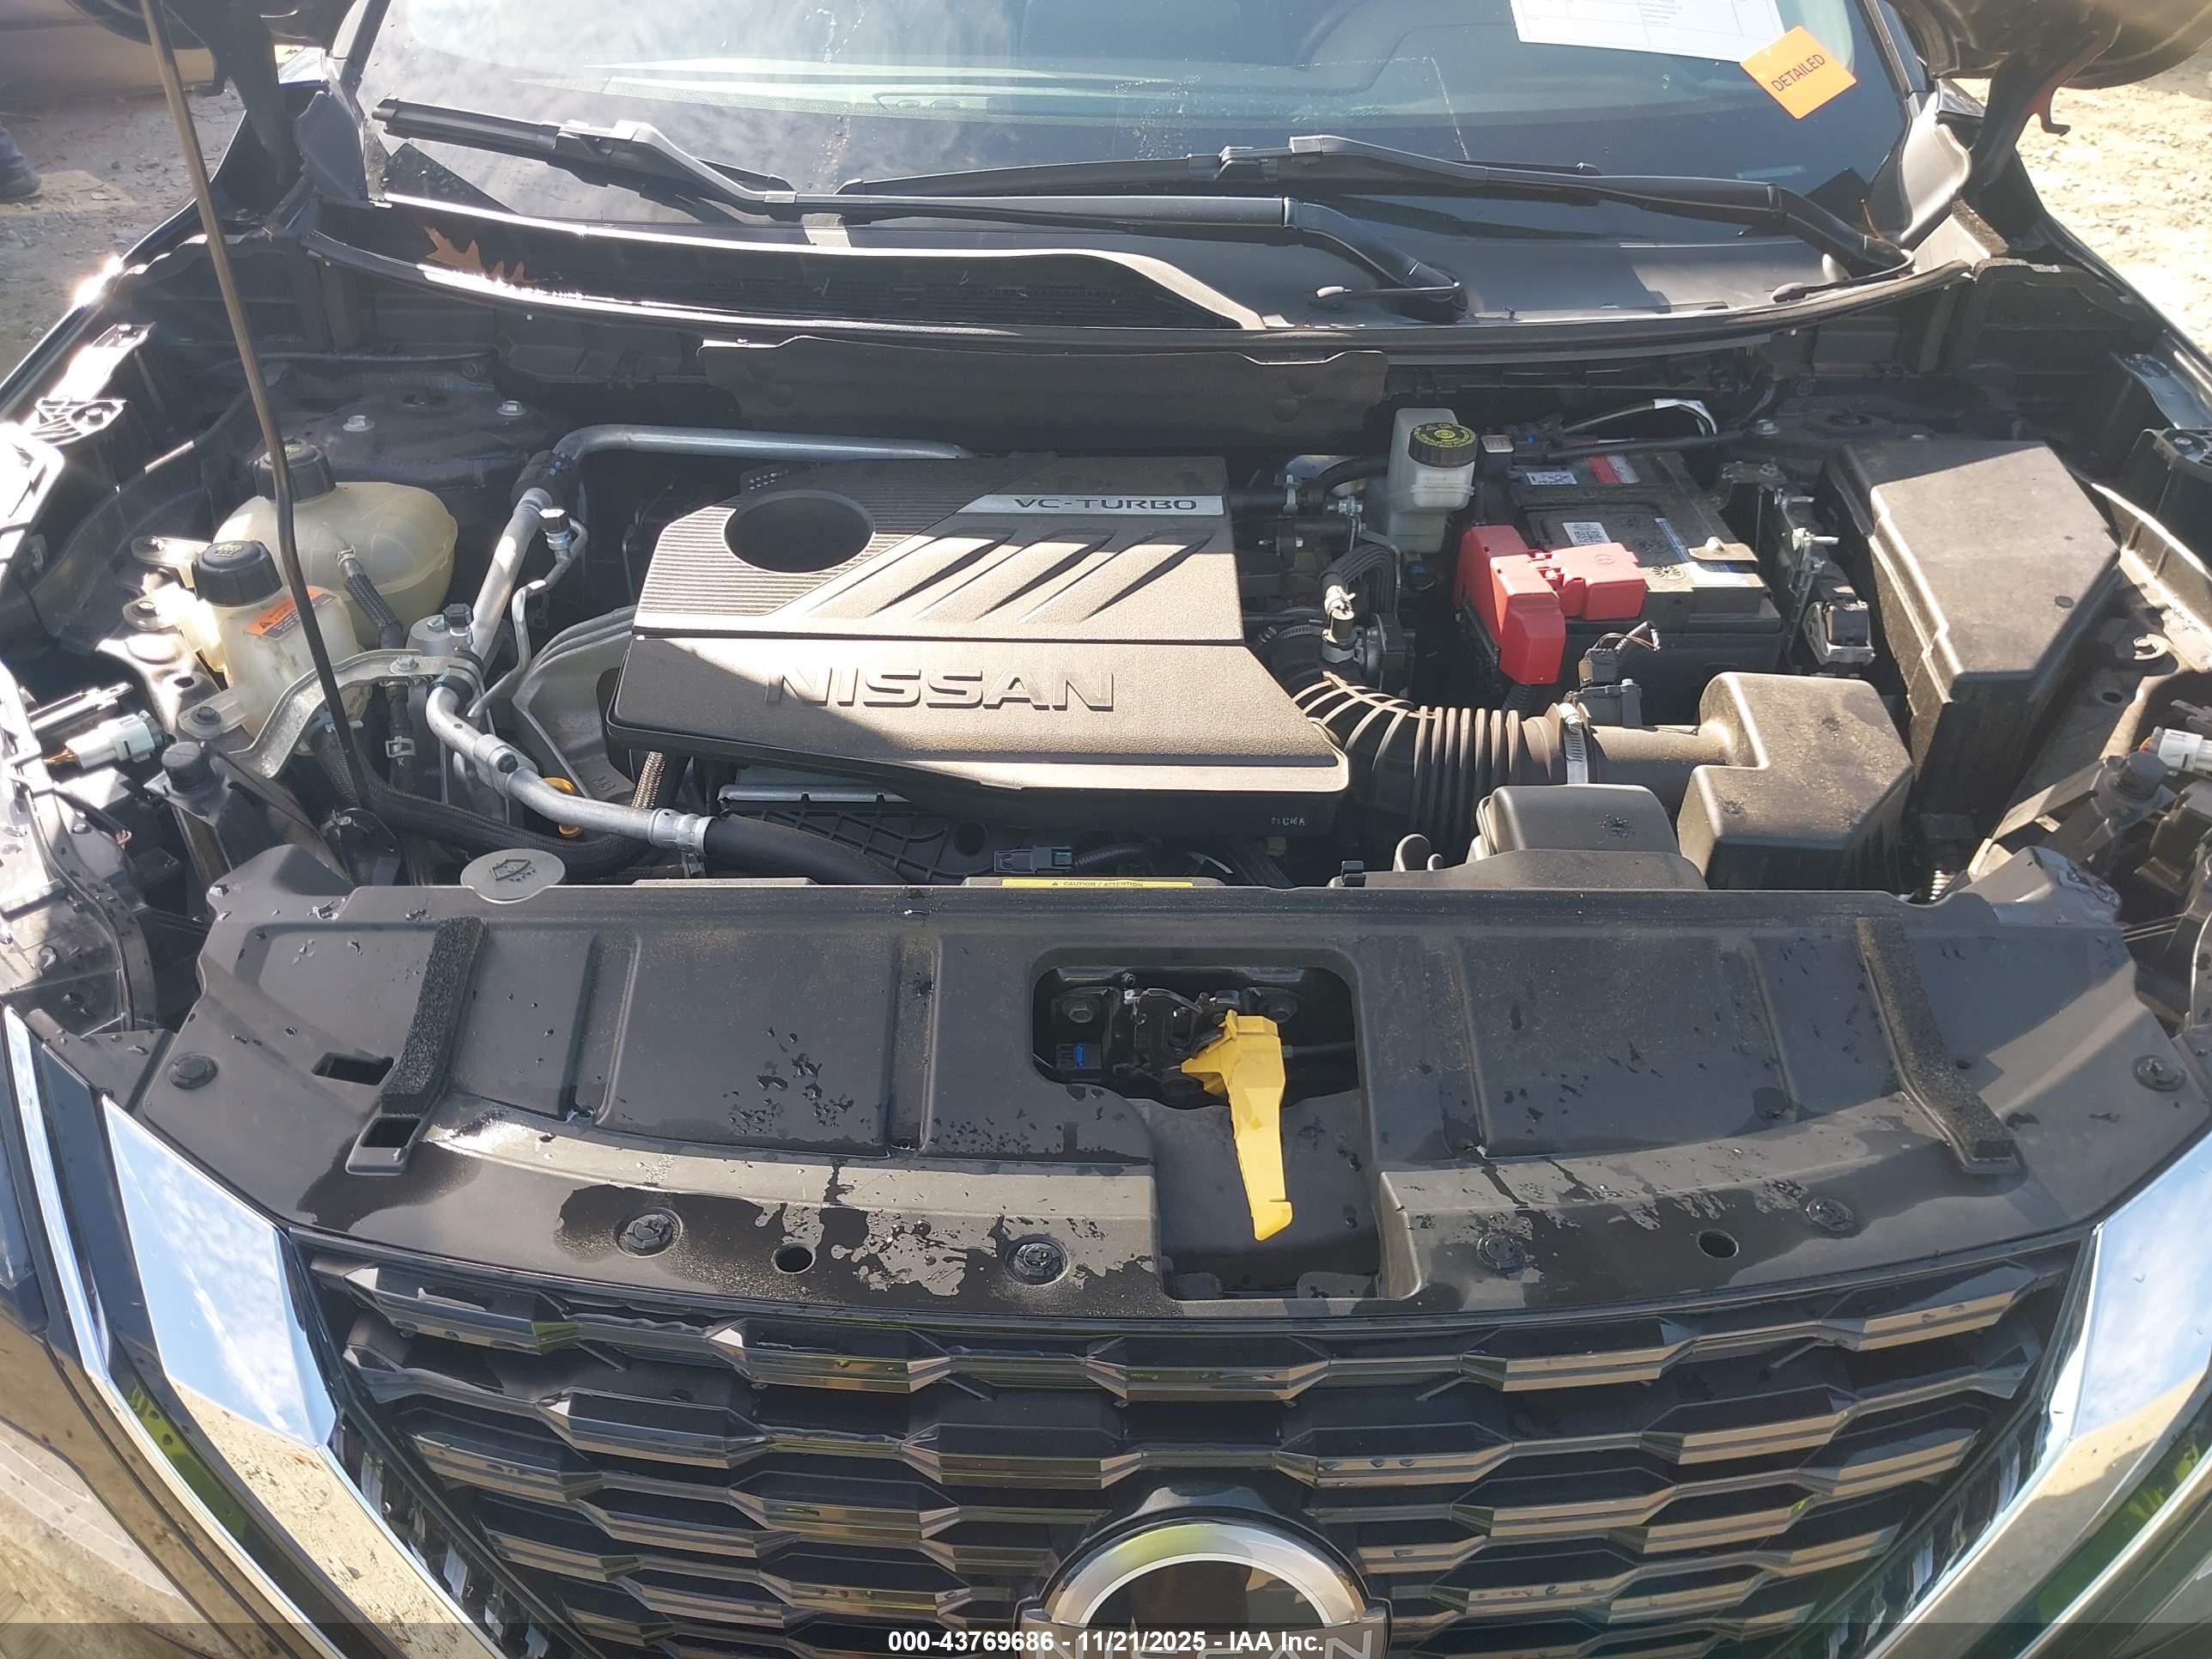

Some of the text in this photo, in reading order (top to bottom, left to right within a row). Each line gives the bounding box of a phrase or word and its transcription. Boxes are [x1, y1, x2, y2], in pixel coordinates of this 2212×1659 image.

[1771, 54, 1826, 92] DETAILED
[1013, 498, 1197, 510] VC-TURBO
[765, 667, 1114, 711] NISSAN
